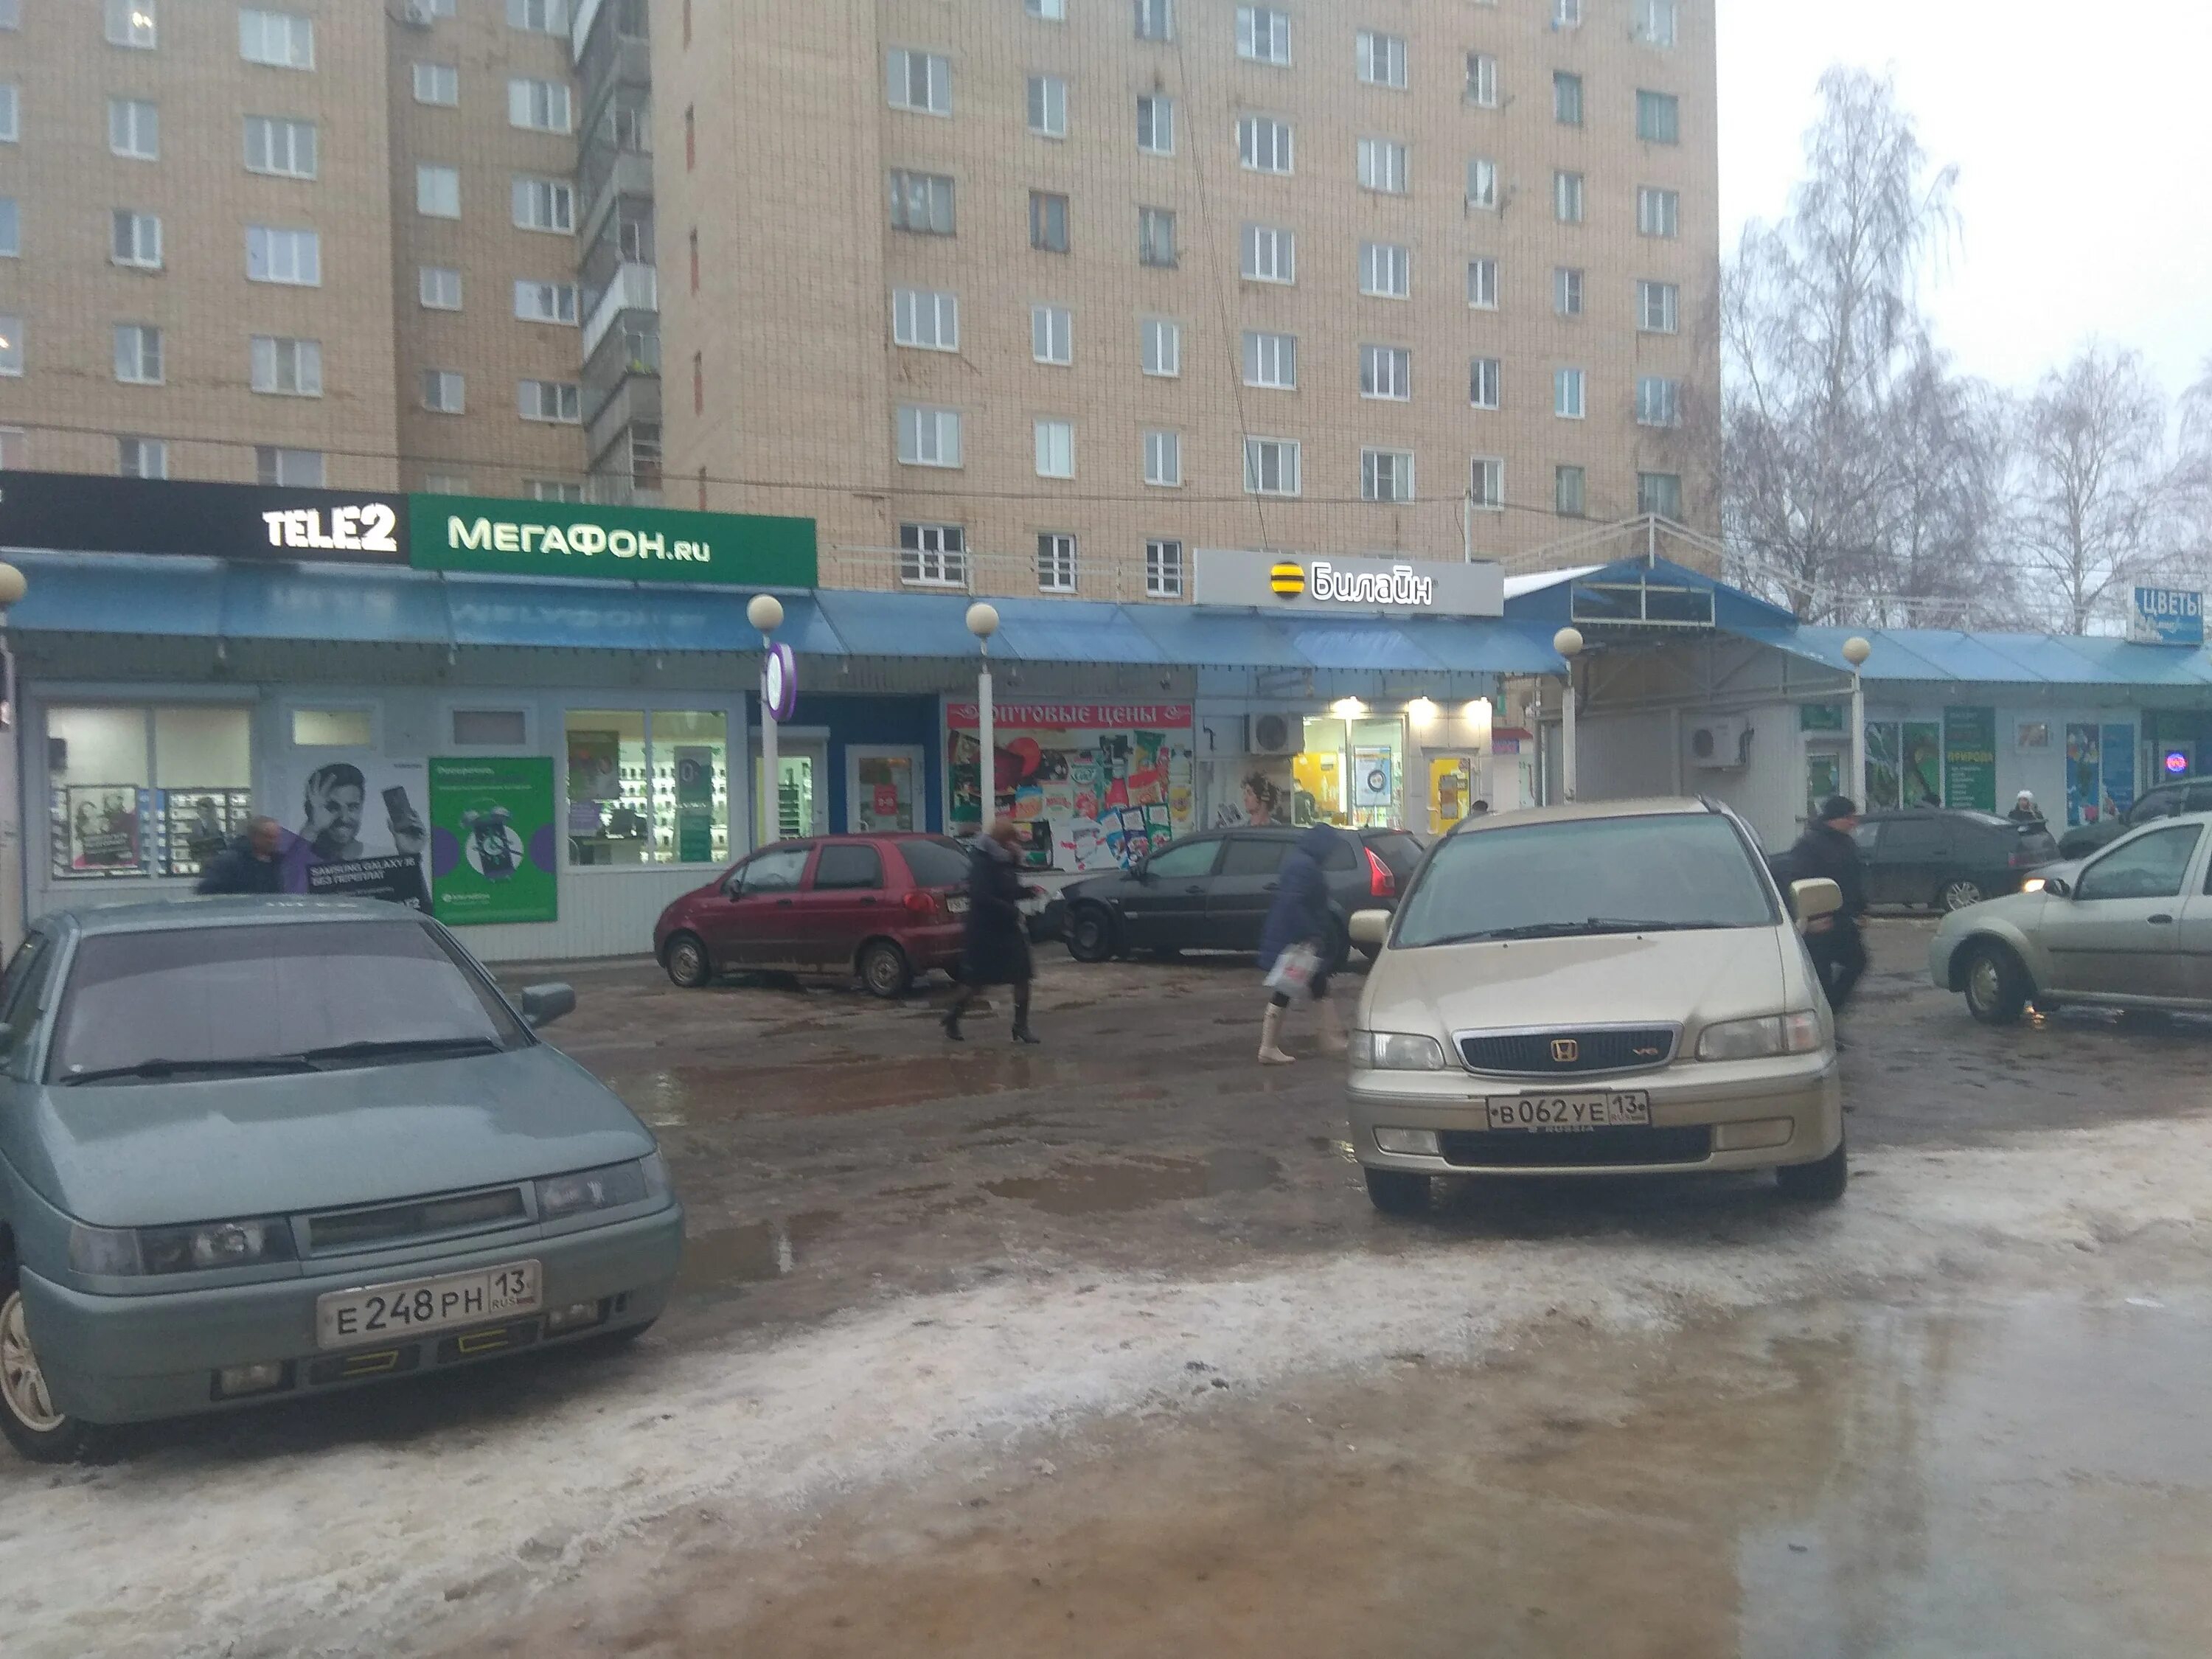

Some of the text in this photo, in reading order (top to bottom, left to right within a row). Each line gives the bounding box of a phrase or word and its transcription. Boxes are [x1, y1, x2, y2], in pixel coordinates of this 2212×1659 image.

[262, 503, 397, 552] TELE2
[1311, 561, 1433, 605] Билайн
[2143, 589, 2202, 616] ЦВЕТЫ
[1097, 706, 1157, 727] ЦЕНЫ
[310, 863, 362, 877] SAMSUNG
[362, 858, 403, 872] GALAXY
[495, 1269, 525, 1297] 13
